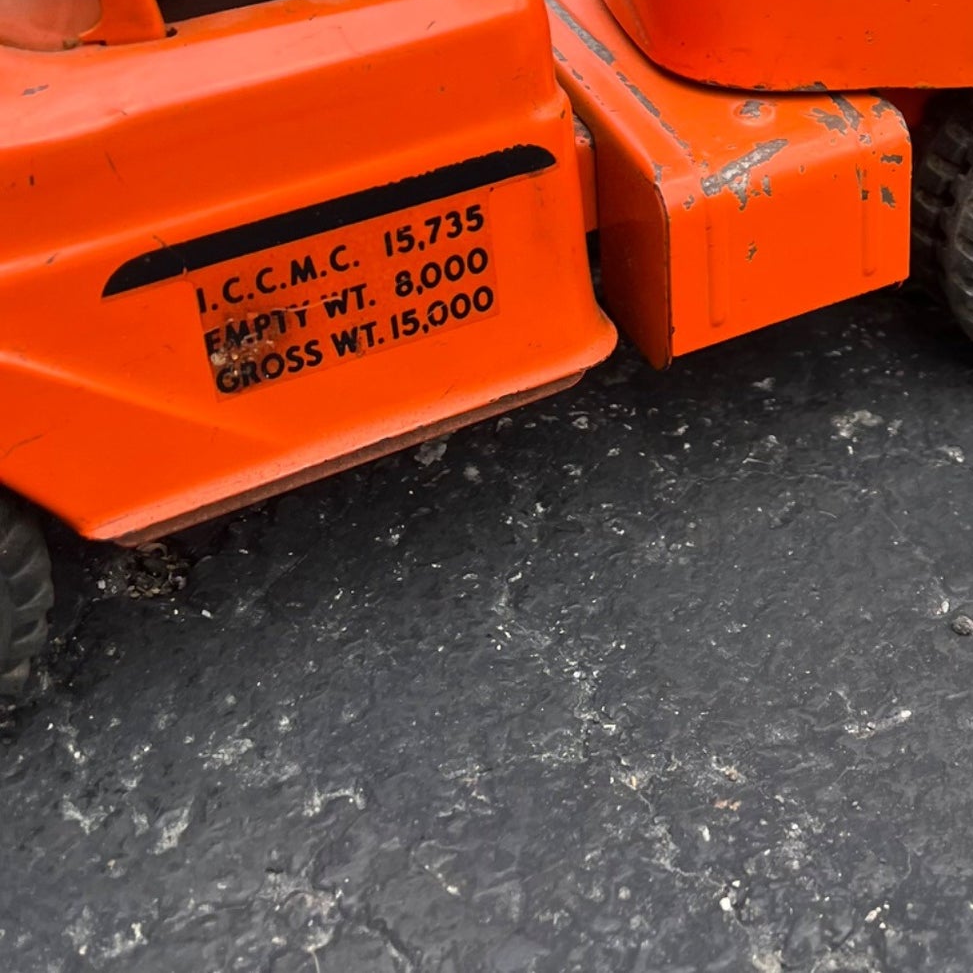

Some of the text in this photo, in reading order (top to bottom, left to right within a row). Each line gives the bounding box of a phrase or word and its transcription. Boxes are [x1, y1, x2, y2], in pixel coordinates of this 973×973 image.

[196, 204, 485, 313] I.C.C.M.C. 15,735
[204, 247, 488, 357] EMPTY WT. 8,000
[215, 286, 494, 394] GROSS WT. 15,000
